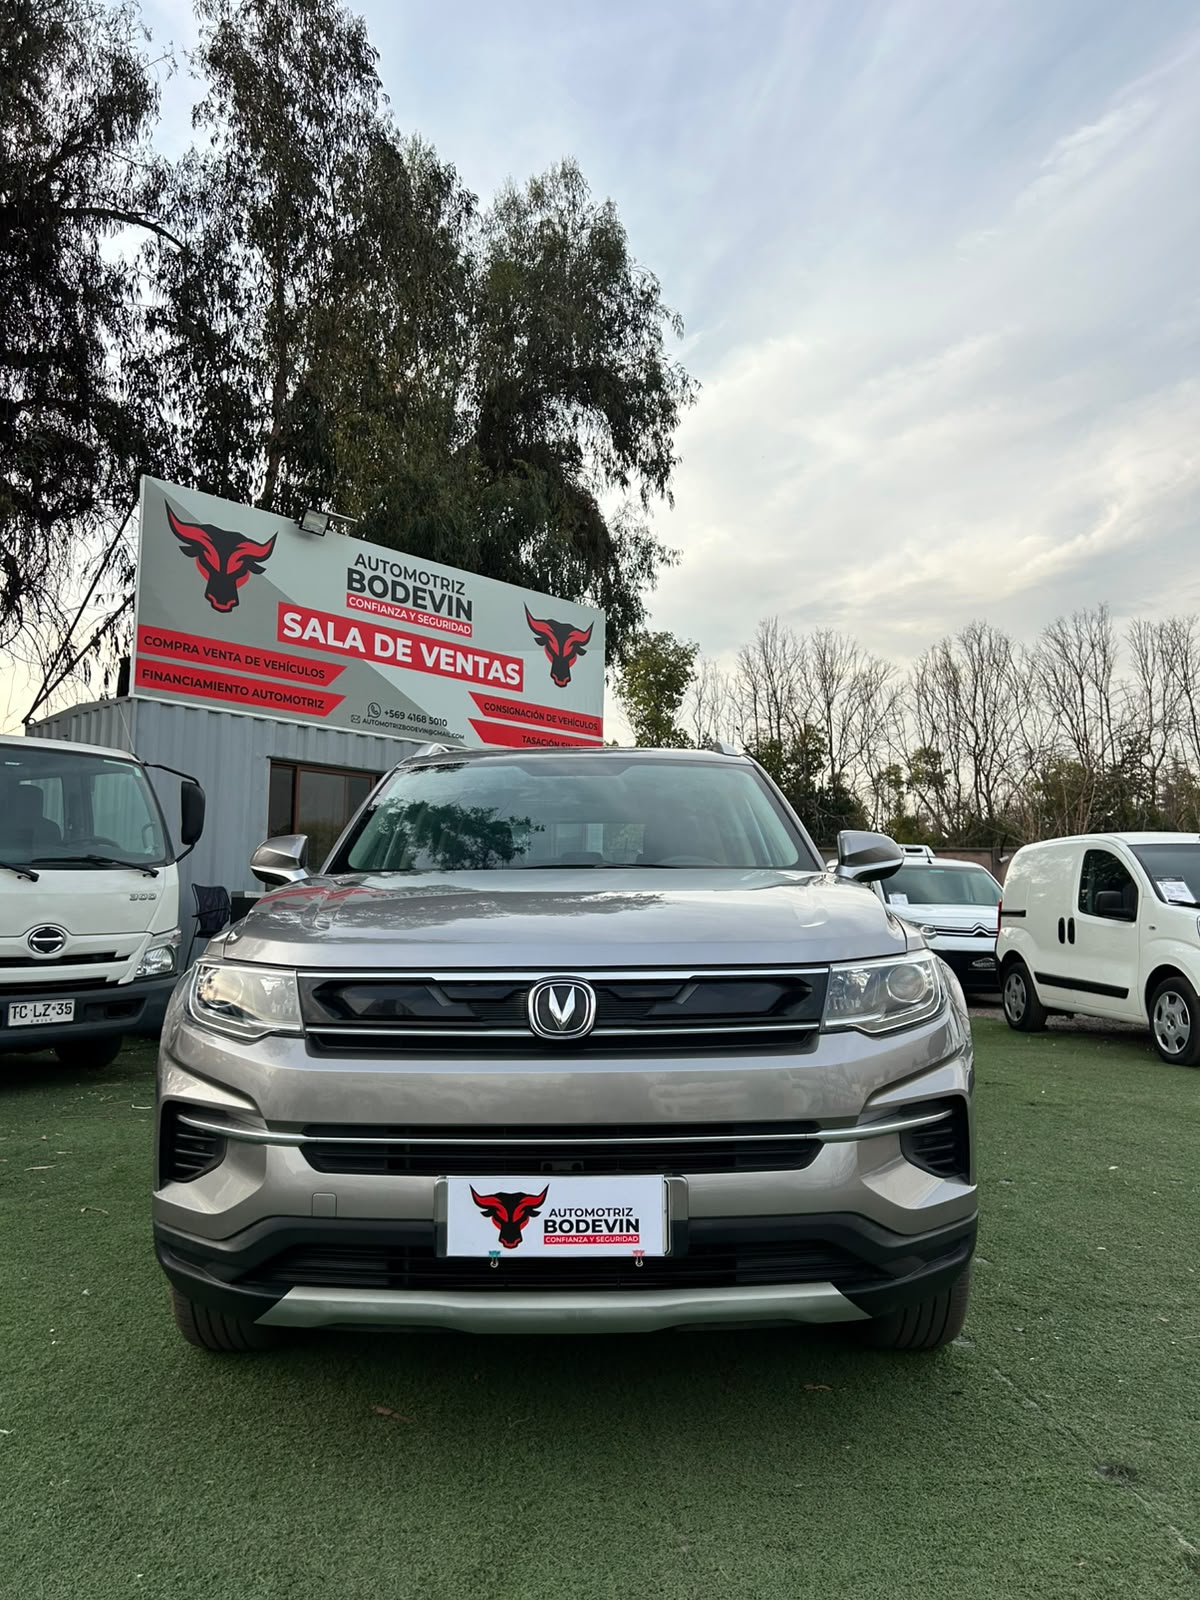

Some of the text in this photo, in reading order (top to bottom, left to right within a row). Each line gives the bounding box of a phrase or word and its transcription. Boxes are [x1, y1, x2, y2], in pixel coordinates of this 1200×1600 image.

[354, 553, 465, 596] AUTOMOTRIZ
[347, 567, 473, 622] BODEVIN
[348, 596, 472, 635] CONFIANZA Y SEGURIDAD
[143, 635, 326, 679] COMPRA VENTA DE VEHÍCULOS
[283, 612, 521, 686] SALA DE VENTAS
[142, 668, 325, 709] FINANCIAMIENTO AUTOMOTRIZ
[384, 709, 448, 727] +569 4168 5010
[484, 702, 598, 731] CONSIGNACIÓN DE VEHÍCULOS
[544, 1218, 640, 1234] BODEVIN
[548, 1207, 634, 1218] AUTOMOTRIZ
[595, 1235, 639, 1243] SEGURIDAD
